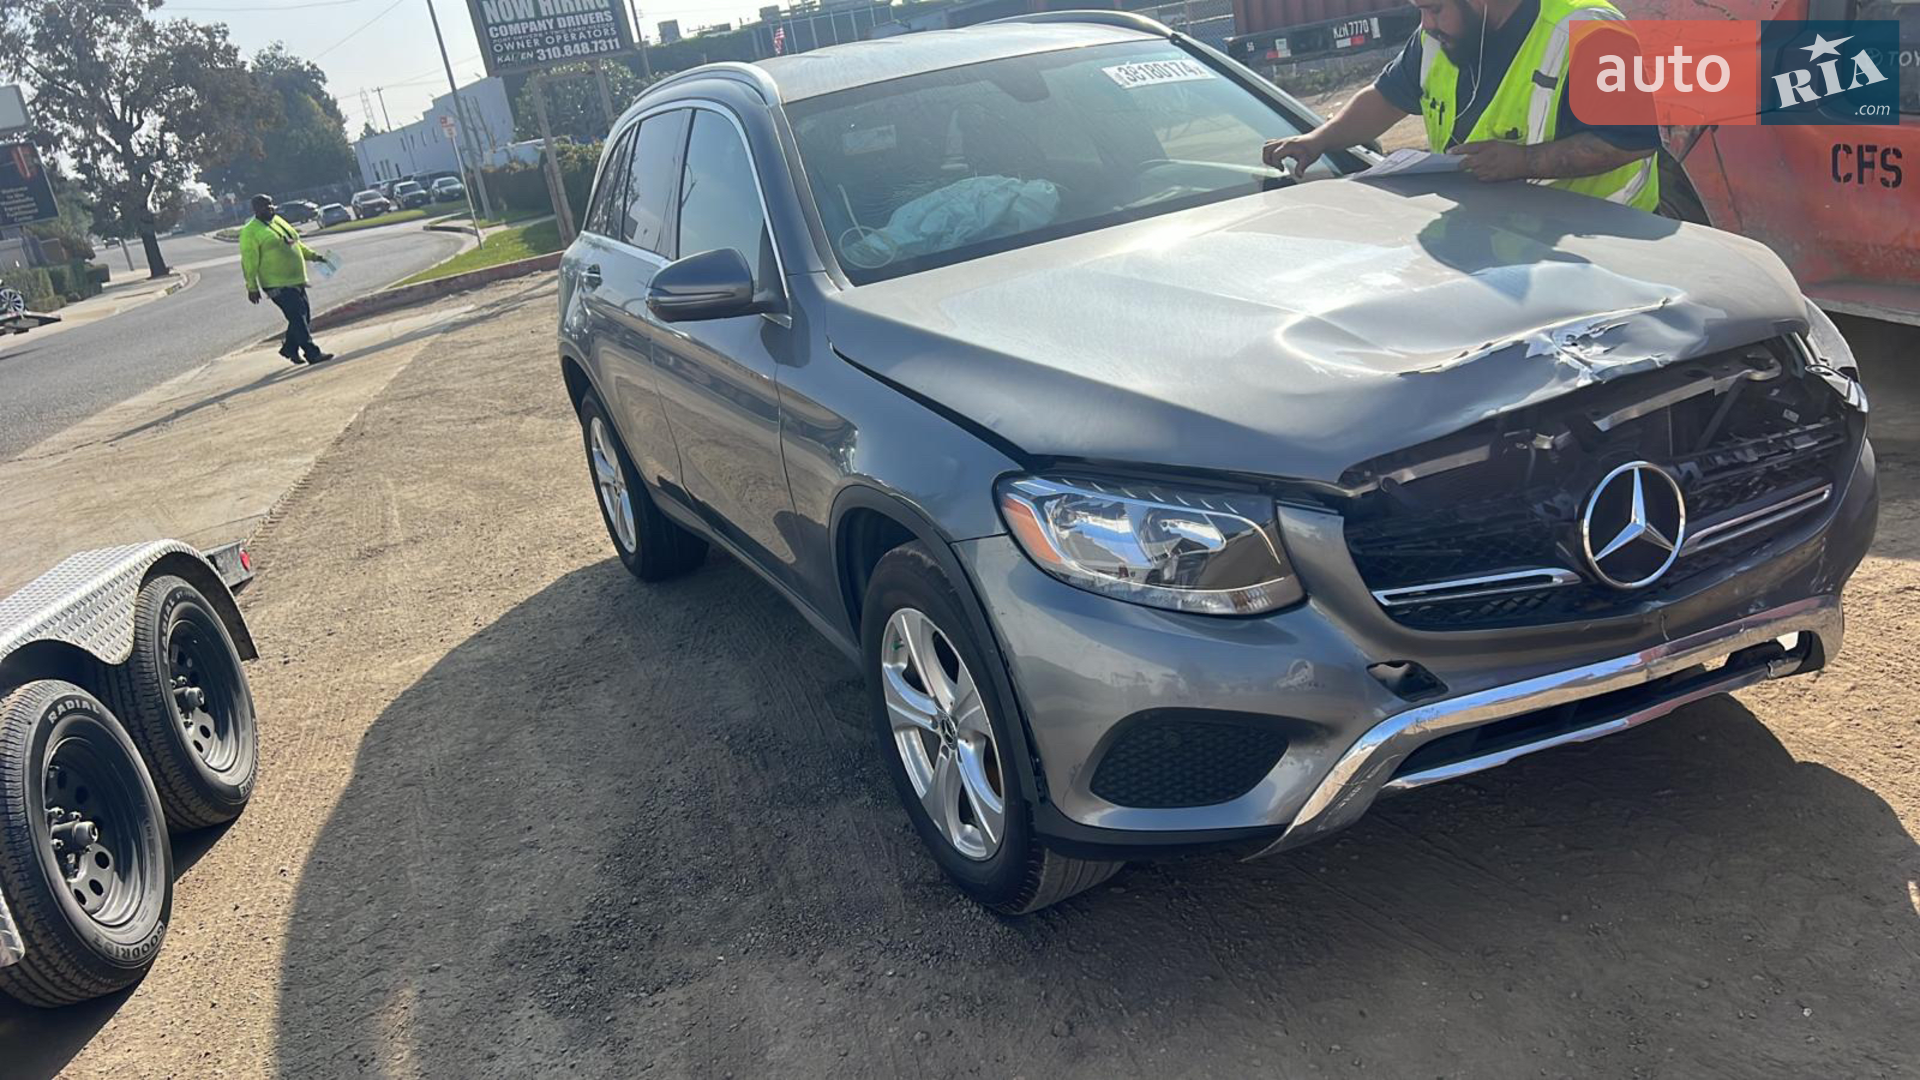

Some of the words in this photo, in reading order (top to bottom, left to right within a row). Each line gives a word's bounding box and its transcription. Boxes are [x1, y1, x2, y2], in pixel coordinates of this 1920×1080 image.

[482, 0, 535, 24] NOW
[489, 18, 554, 39] COMPANY
[557, 10, 613, 29] DRIVERS
[493, 38, 540, 53] OWNER
[545, 27, 617, 45] OPERATORS
[536, 37, 621, 61] 310.848.7311
[1831, 143, 1903, 189] CFS
[48, 699, 101, 724] RADIAL
